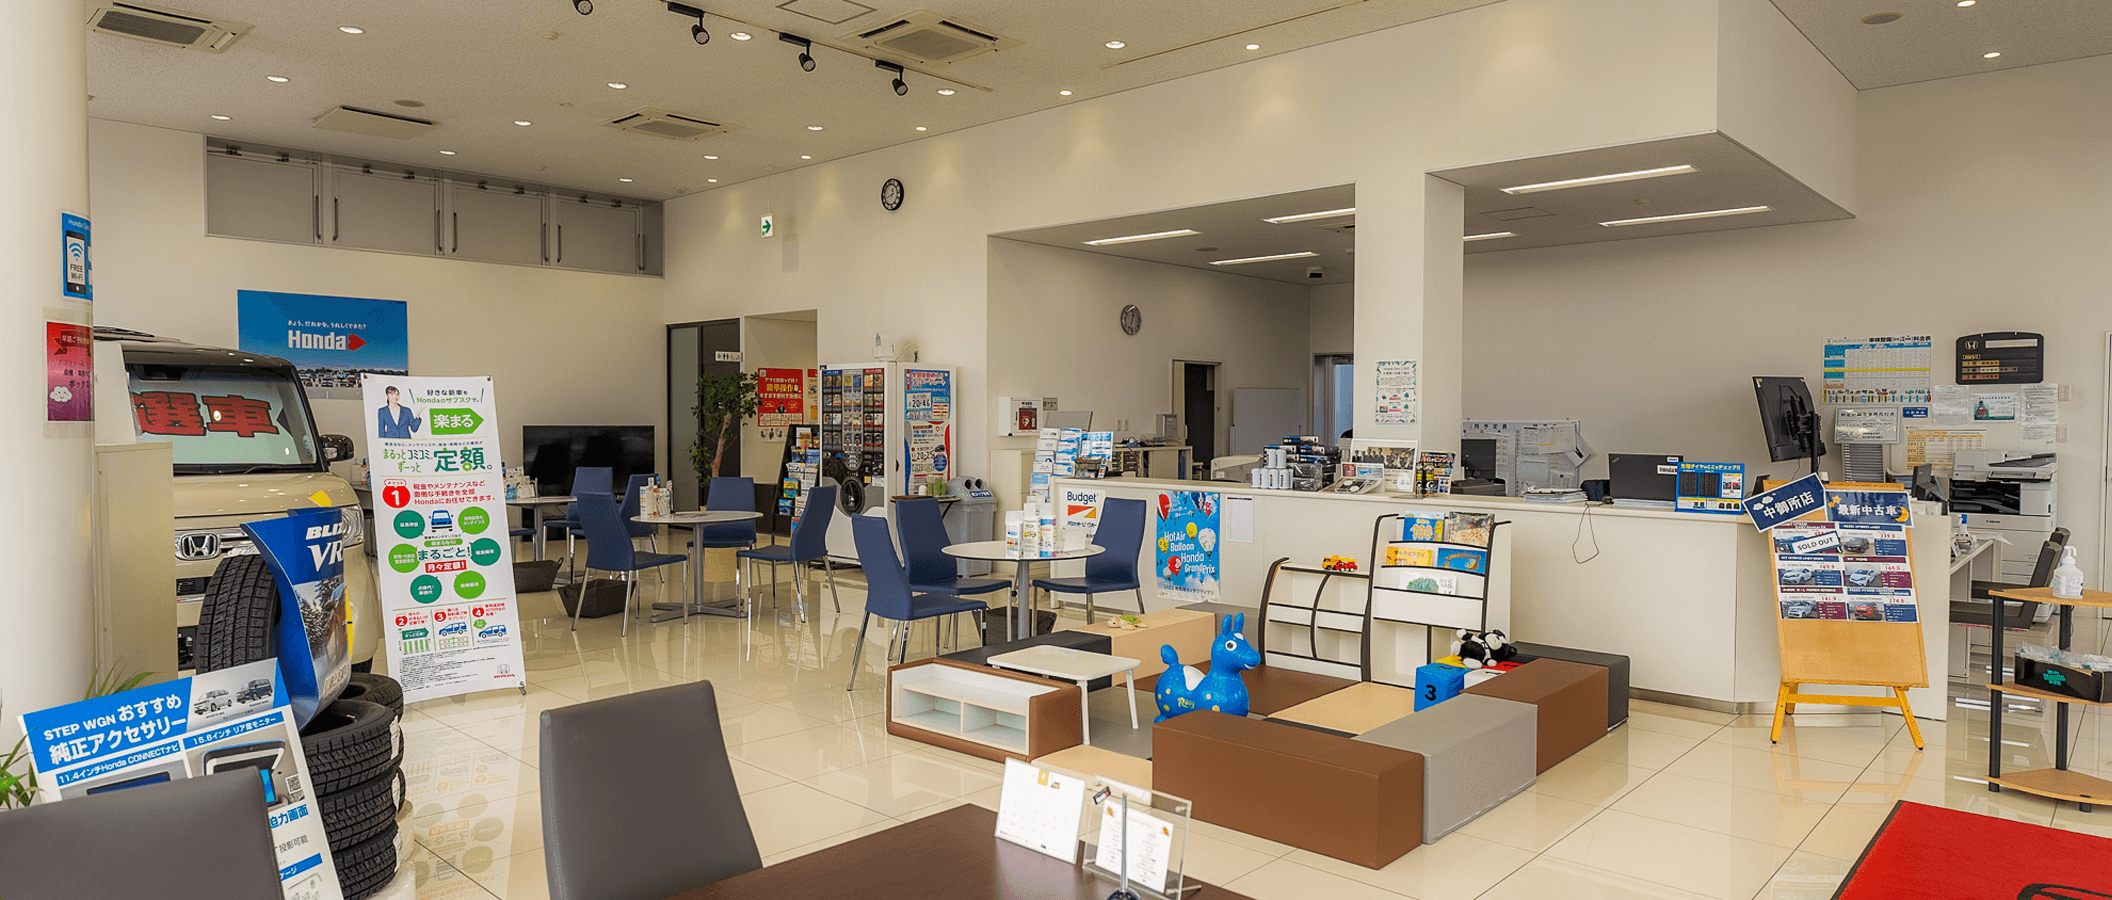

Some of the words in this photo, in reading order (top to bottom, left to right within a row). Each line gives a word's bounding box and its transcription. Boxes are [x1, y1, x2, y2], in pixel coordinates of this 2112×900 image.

[70, 264, 83, 273] FREE
[71, 273, 83, 281] Wi-Fi
[287, 329, 347, 351] Honda
[433, 413, 475, 430] 楽まる
[397, 461, 421, 473] ずーっと
[412, 479, 486, 491] 税金やメンテナンスなど
[391, 489, 401, 507] 1
[413, 494, 496, 506] Hondaにお任せできます。
[1066, 490, 1097, 505] Budget
[1763, 491, 1815, 519] 中御所店
[1837, 504, 1898, 517] 最新中古車
[1411, 524, 1433, 540] 100
[1170, 542, 1195, 552] Balloon
[1797, 541, 1818, 551] SOLD
[1818, 537, 1834, 546] OUT
[417, 546, 472, 561] まるごと!
[1181, 551, 1205, 563] Honda
[427, 561, 466, 573] 月々定額!
[436, 610, 444, 621] 3
[474, 606, 483, 617] 4
[398, 615, 405, 627] 2
[1424, 684, 1437, 701] 3
[43, 723, 81, 741] STEP
[82, 713, 117, 731] WGN
[116, 693, 182, 722] おすすめ
[48, 716, 187, 765] 純正アクセサリー
[192, 729, 231, 745] 15.6インチ
[127, 742, 179, 764] CONNECTナビ
[274, 834, 309, 853] 投影可能
